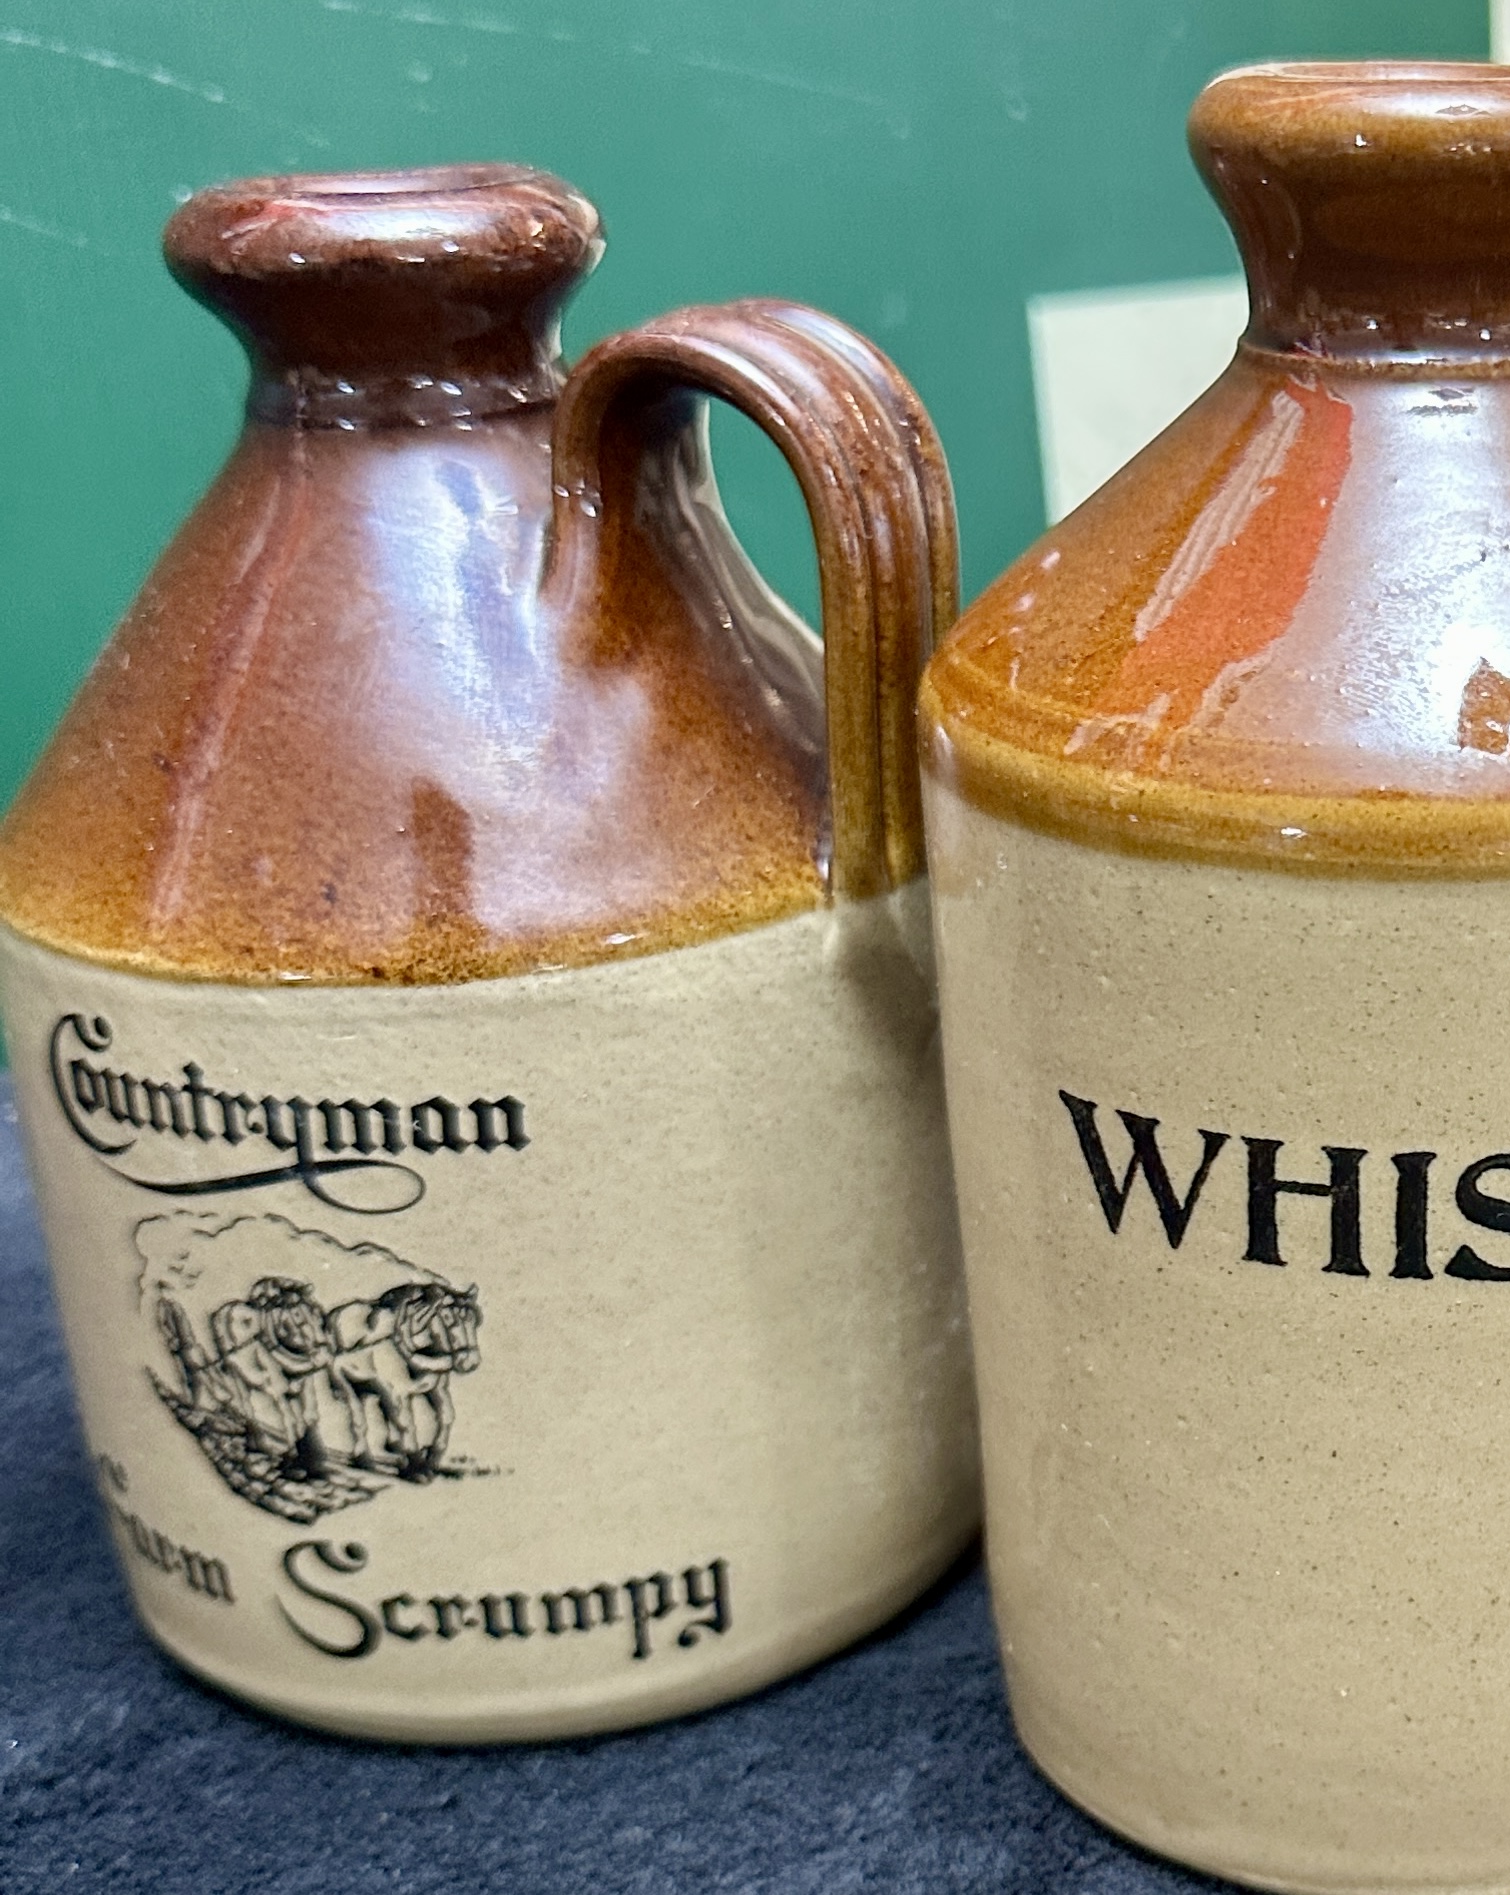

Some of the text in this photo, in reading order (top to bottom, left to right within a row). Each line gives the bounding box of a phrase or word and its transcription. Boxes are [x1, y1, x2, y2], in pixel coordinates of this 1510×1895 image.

[49, 1013, 532, 1215] Countryman
[100, 1454, 732, 1660] arm Scrumpy
